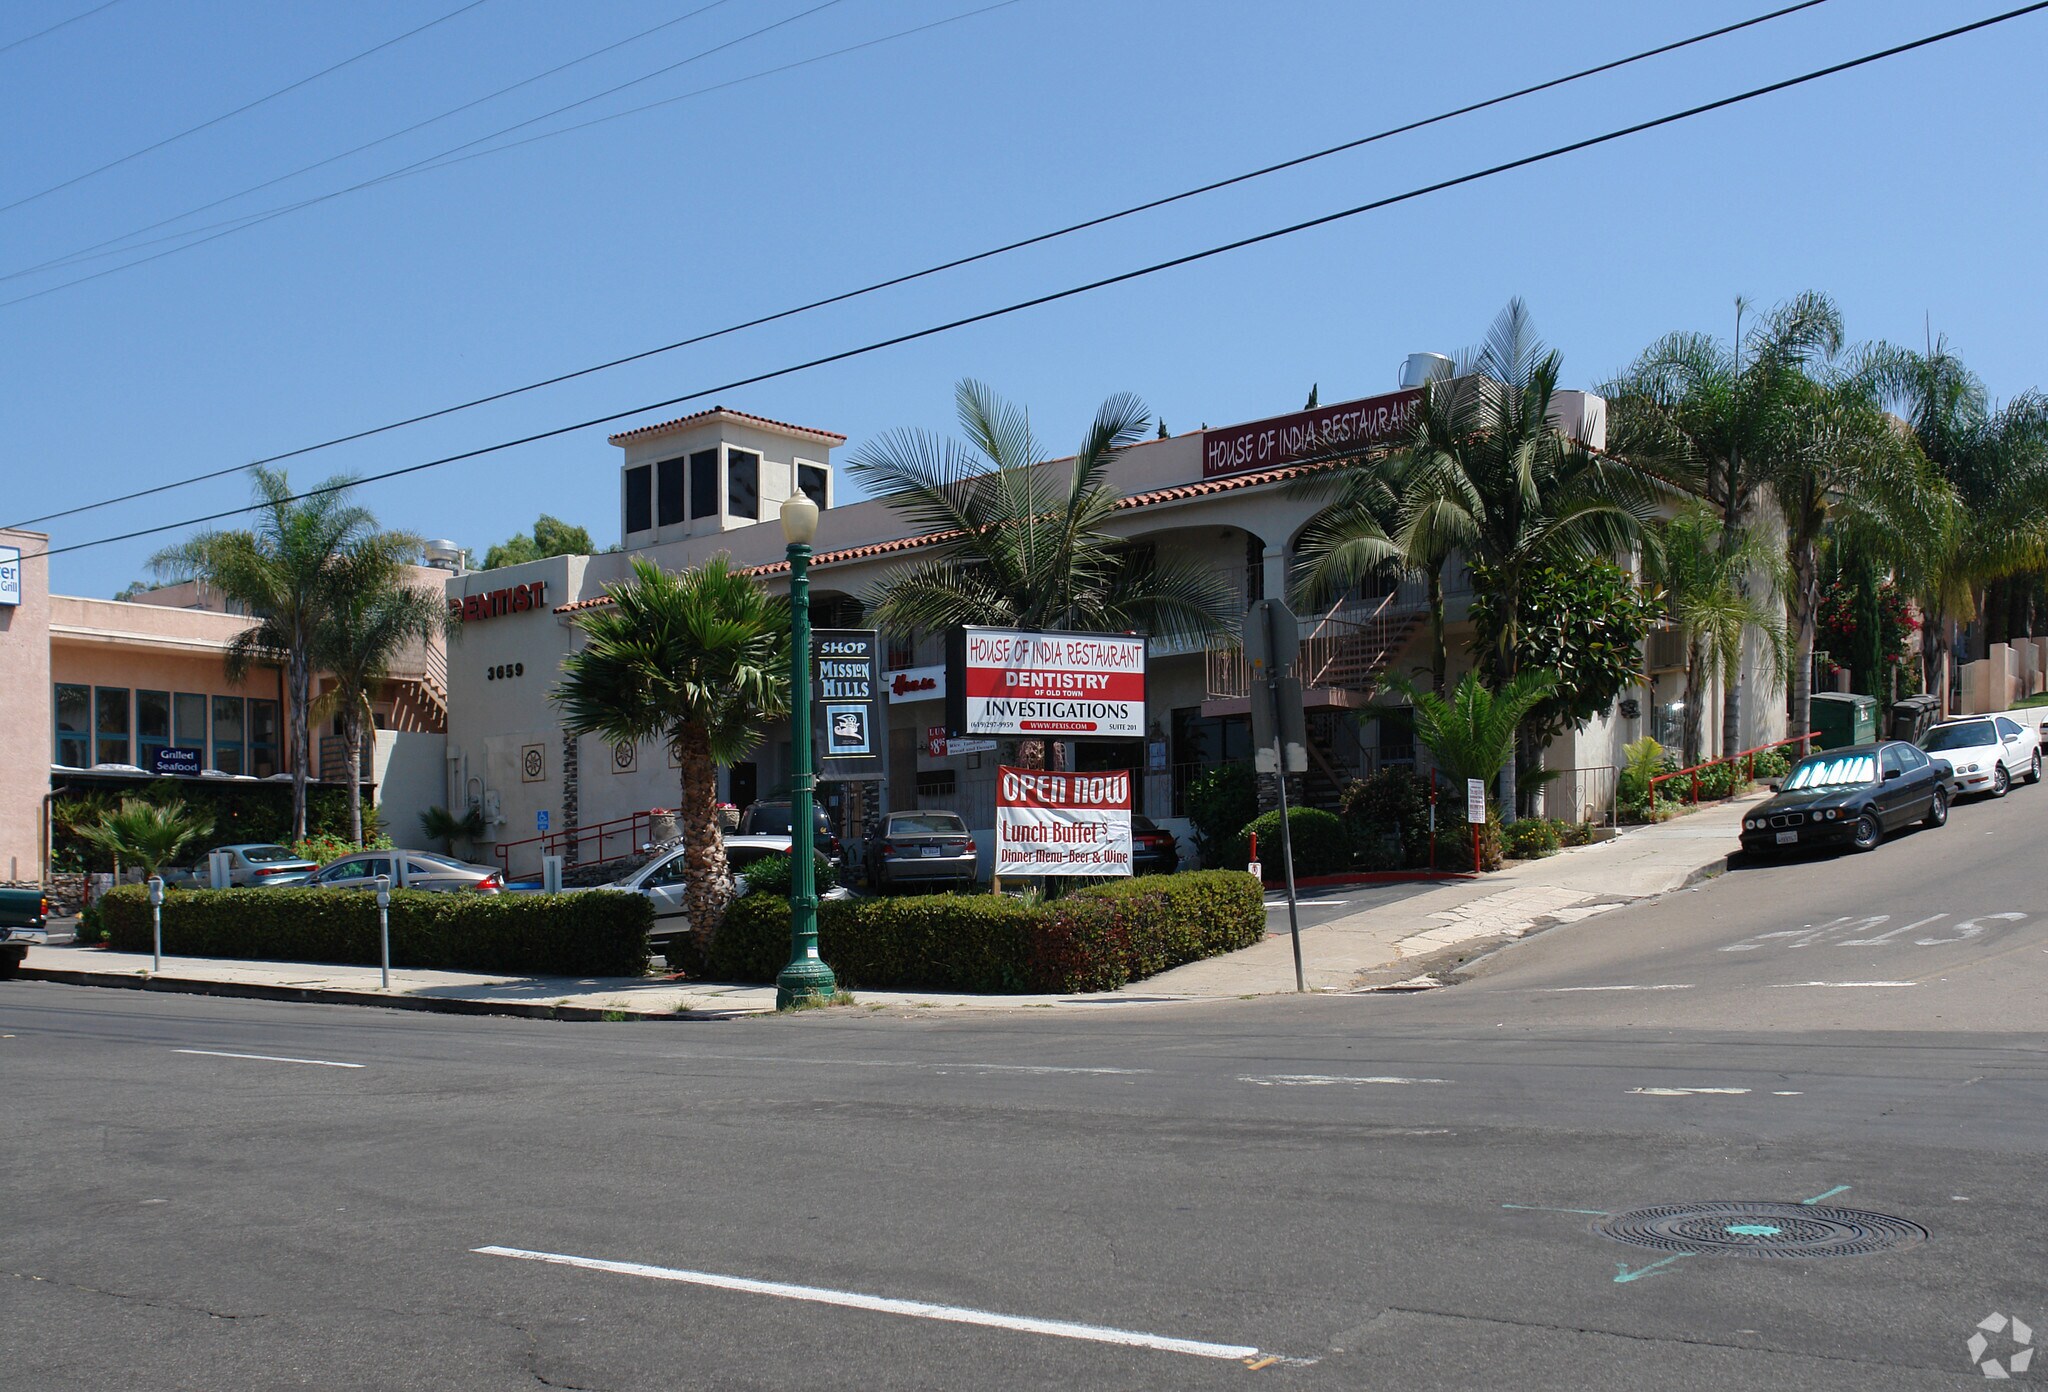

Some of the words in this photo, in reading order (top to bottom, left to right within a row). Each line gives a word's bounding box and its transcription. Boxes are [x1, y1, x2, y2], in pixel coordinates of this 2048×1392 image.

[1208, 434, 1253, 470] HOUSE
[1258, 430, 1275, 460] OF
[1279, 420, 1317, 455] INDIA
[1321, 400, 1420, 444] RESTAURANT
[1, 581, 17, 592] Grill
[821, 642, 867, 654] SHOP
[970, 637, 1010, 663] HOUSE
[1014, 640, 1029, 664] OF
[1032, 641, 1062, 666] INDIA
[1066, 642, 1142, 668] RESTAURANT
[487, 663, 525, 681] 3659
[819, 661, 870, 681] MISSION
[822, 679, 870, 697] HILLS
[1005, 671, 1110, 690] DENTISTRY
[986, 700, 1129, 720] INVESTIGATIONS
[1109, 723, 1126, 731] SUITE
[160, 750, 195, 760] Grilled
[156, 761, 198, 771] Seafood
[1002, 773, 1066, 803] OPEN
[1073, 776, 1128, 804] NOW
[1002, 820, 1048, 843] Lunch
[1052, 821, 1098, 843] Buffet
[1001, 849, 1033, 863] Dinner
[1092, 851, 1101, 863] &
[1103, 850, 1128, 864] Wine
